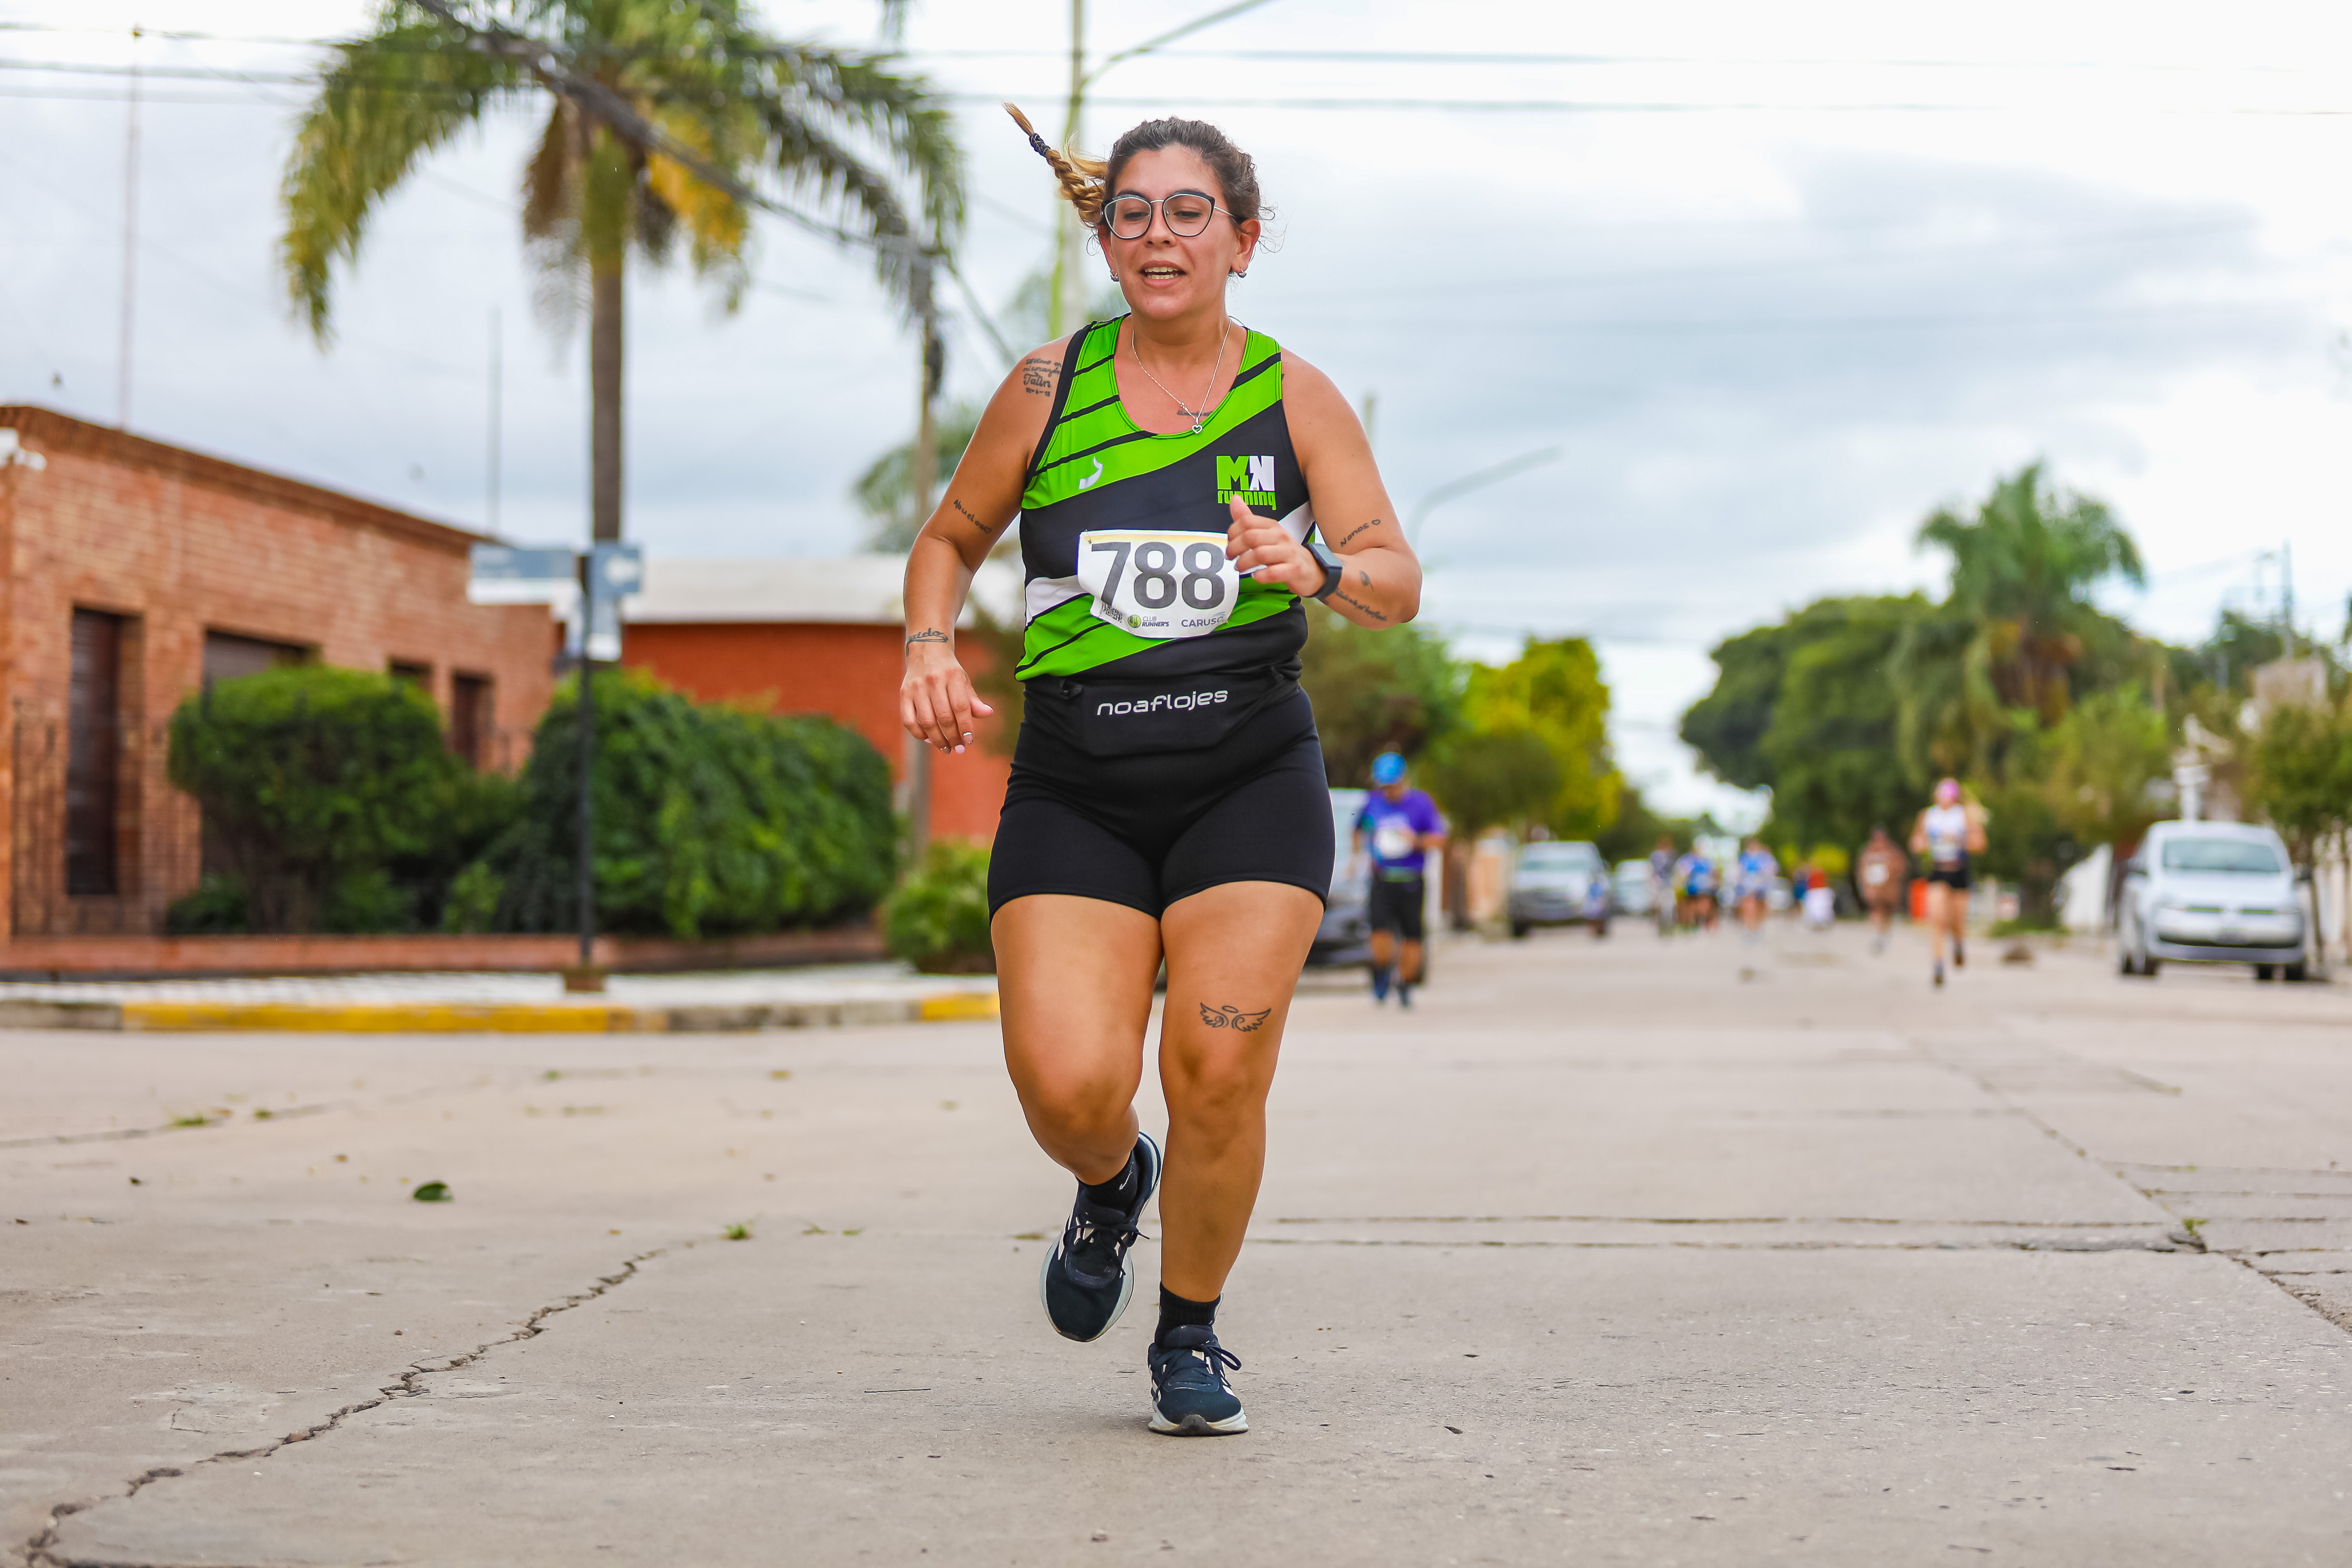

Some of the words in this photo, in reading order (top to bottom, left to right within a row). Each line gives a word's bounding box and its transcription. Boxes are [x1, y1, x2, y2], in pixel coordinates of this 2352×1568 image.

[1217, 455, 1275, 491] MN
[1091, 541, 1225, 610] 788
[1097, 690, 1228, 716] noaflojes
